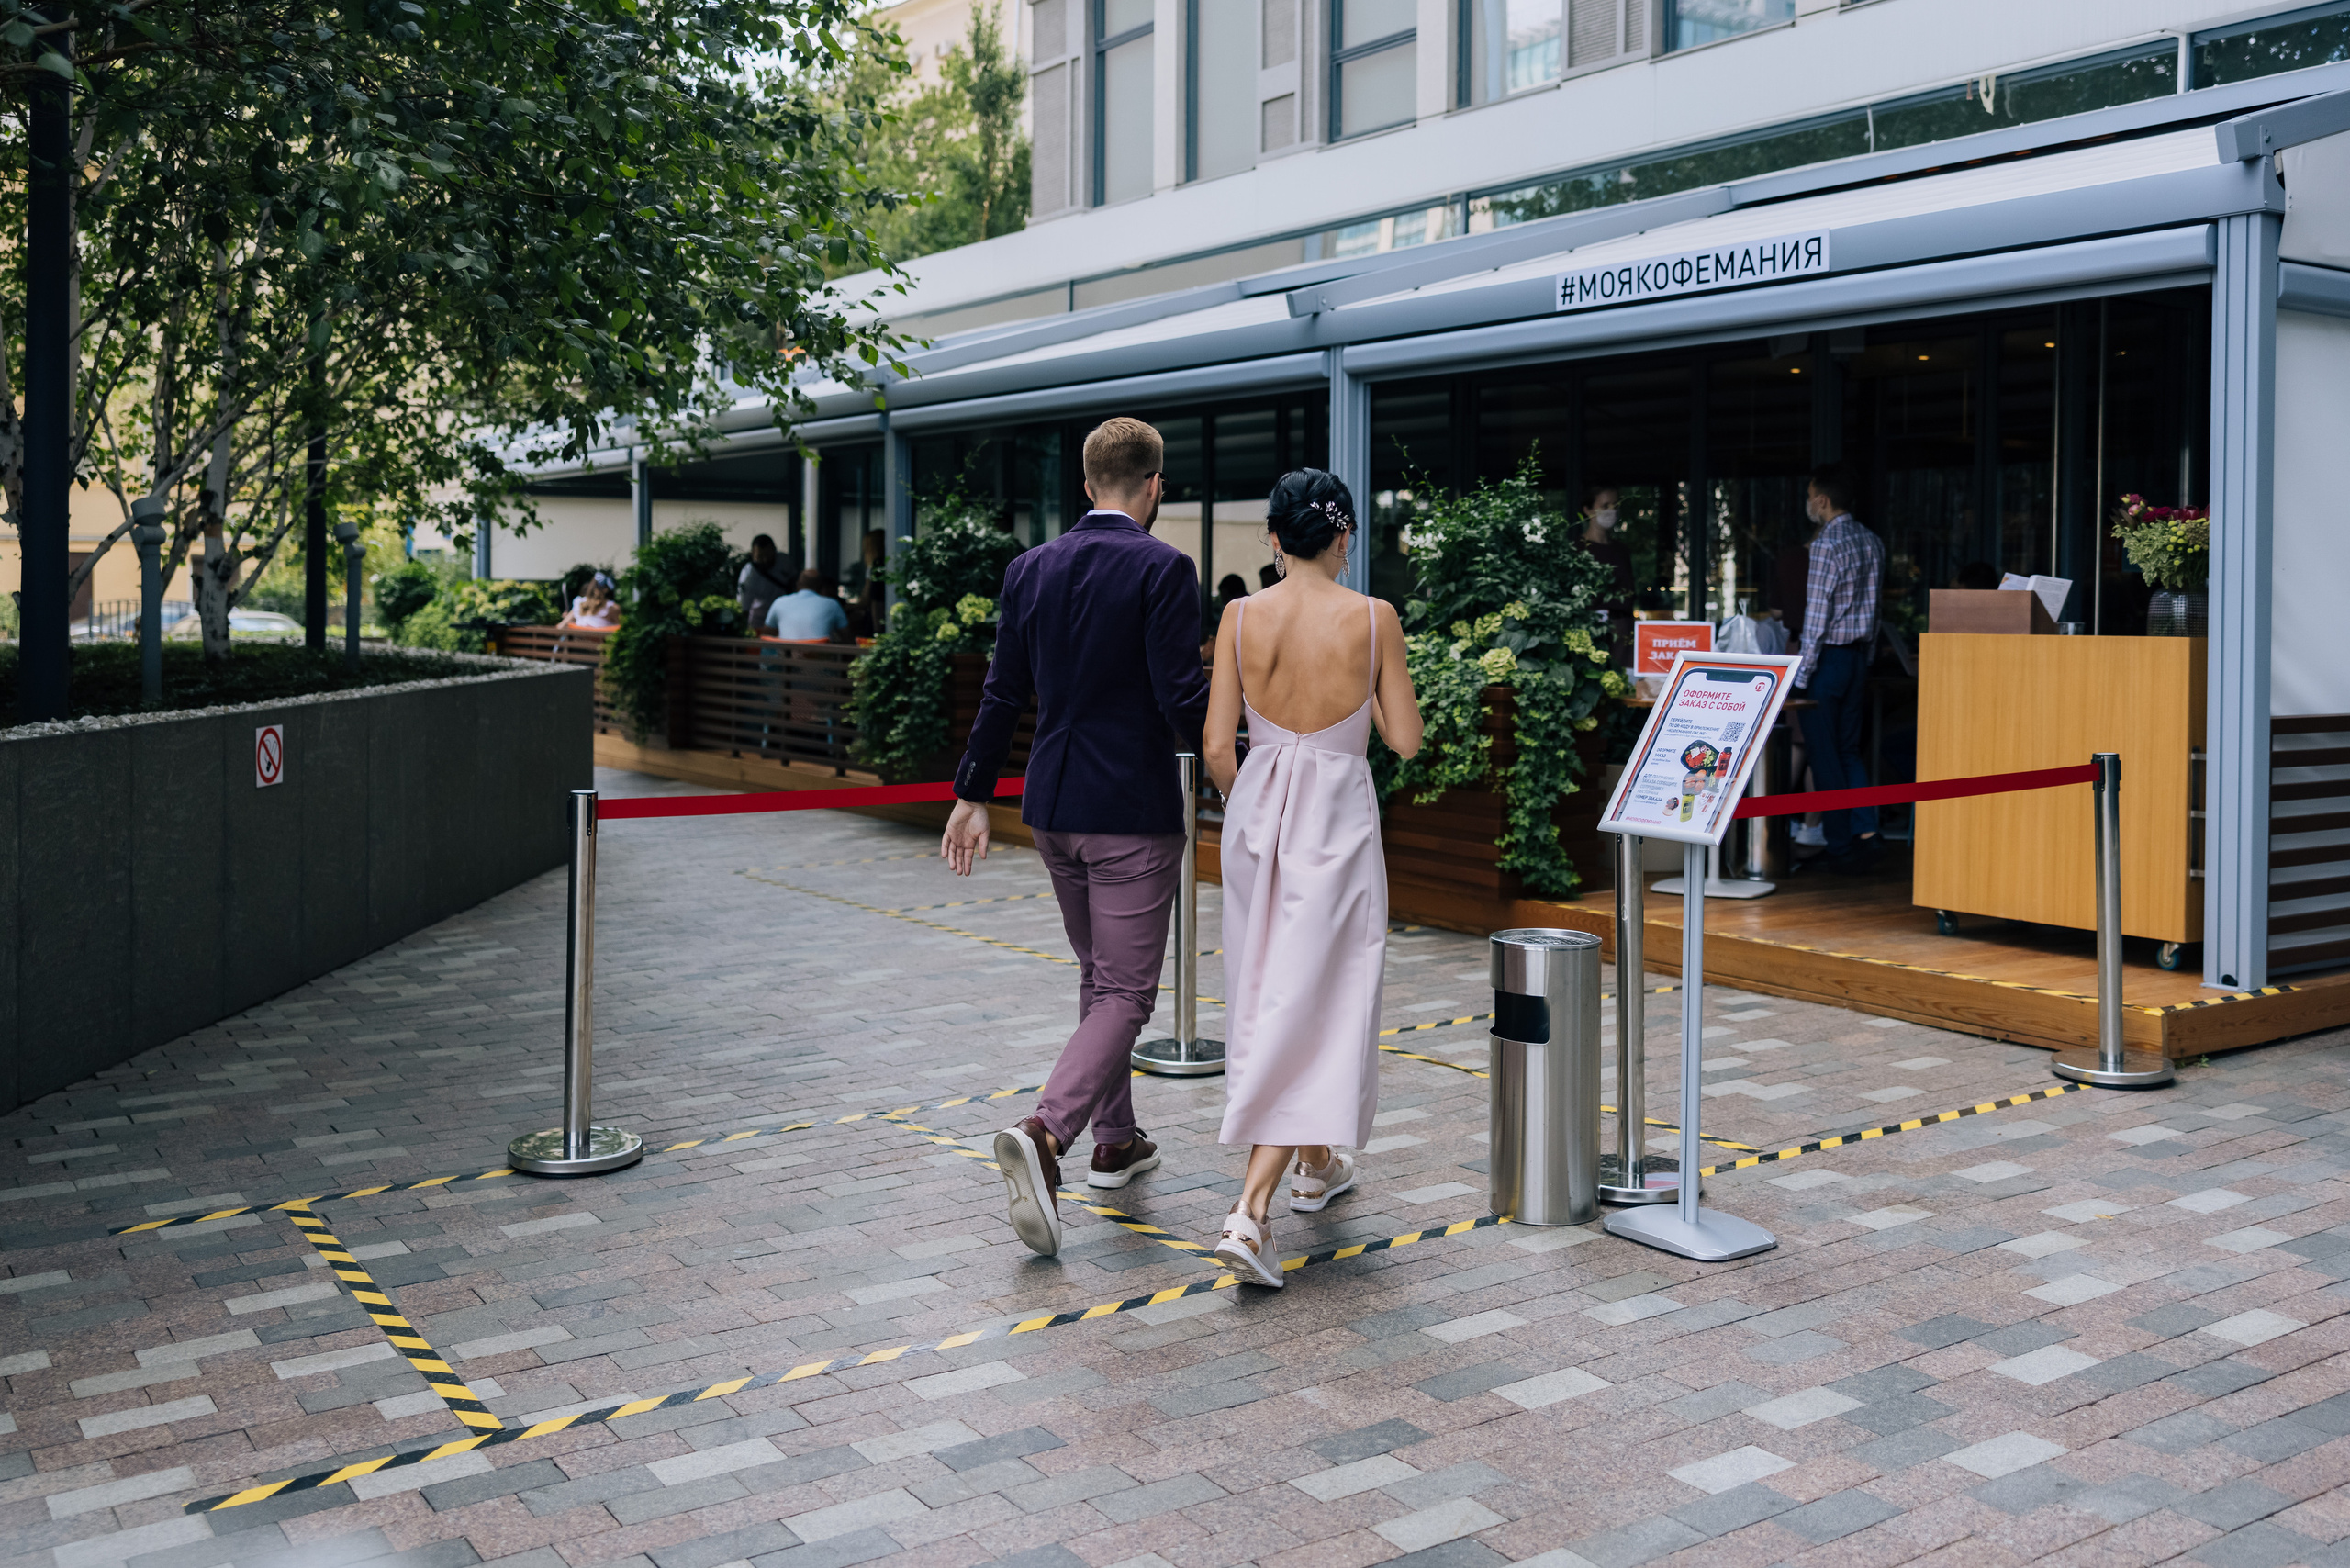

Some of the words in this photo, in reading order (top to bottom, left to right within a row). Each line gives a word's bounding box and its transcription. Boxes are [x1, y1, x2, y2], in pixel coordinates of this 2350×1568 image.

[1561, 236, 1821, 305] #МОЯКОФЕМАНИЯ
[1652, 637, 1696, 648] ПРИЁМ
[1683, 689, 1732, 700] ОФОРМИТЕ
[1678, 699, 1707, 709] ЗАКАЗ
[1708, 701, 1715, 710] С
[1716, 701, 1746, 711] СОБОЙ
